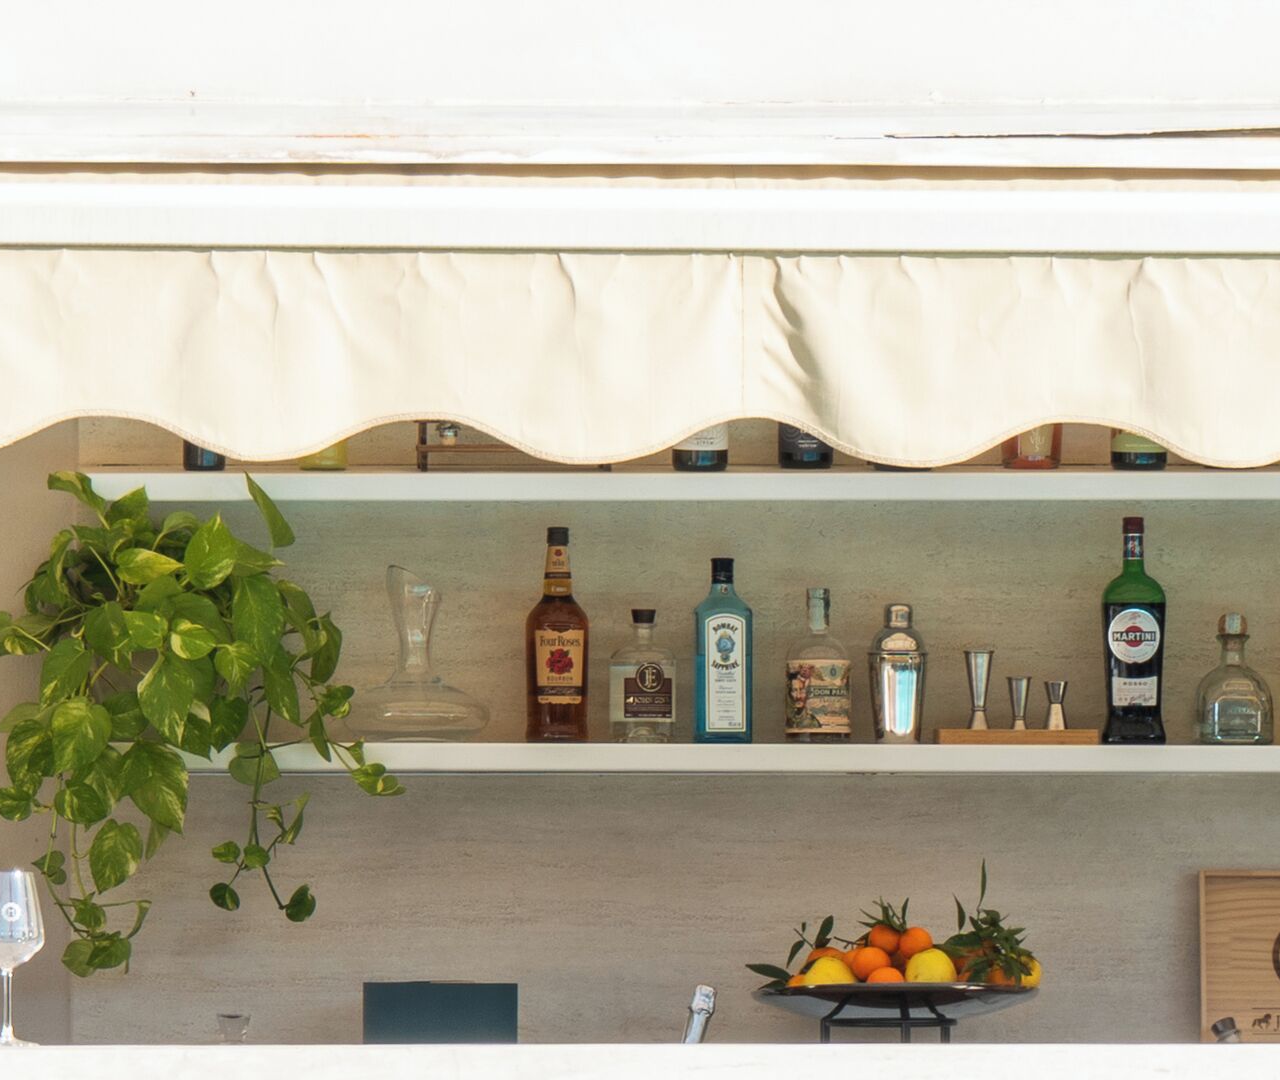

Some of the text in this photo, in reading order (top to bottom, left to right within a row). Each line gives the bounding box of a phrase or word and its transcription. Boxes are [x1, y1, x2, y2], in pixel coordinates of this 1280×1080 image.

[712, 622, 738, 634] BOMBAY
[539, 635, 557, 647] Four
[1113, 632, 1155, 641] MARTINI
[711, 659, 740, 670] SAPPHIRE
